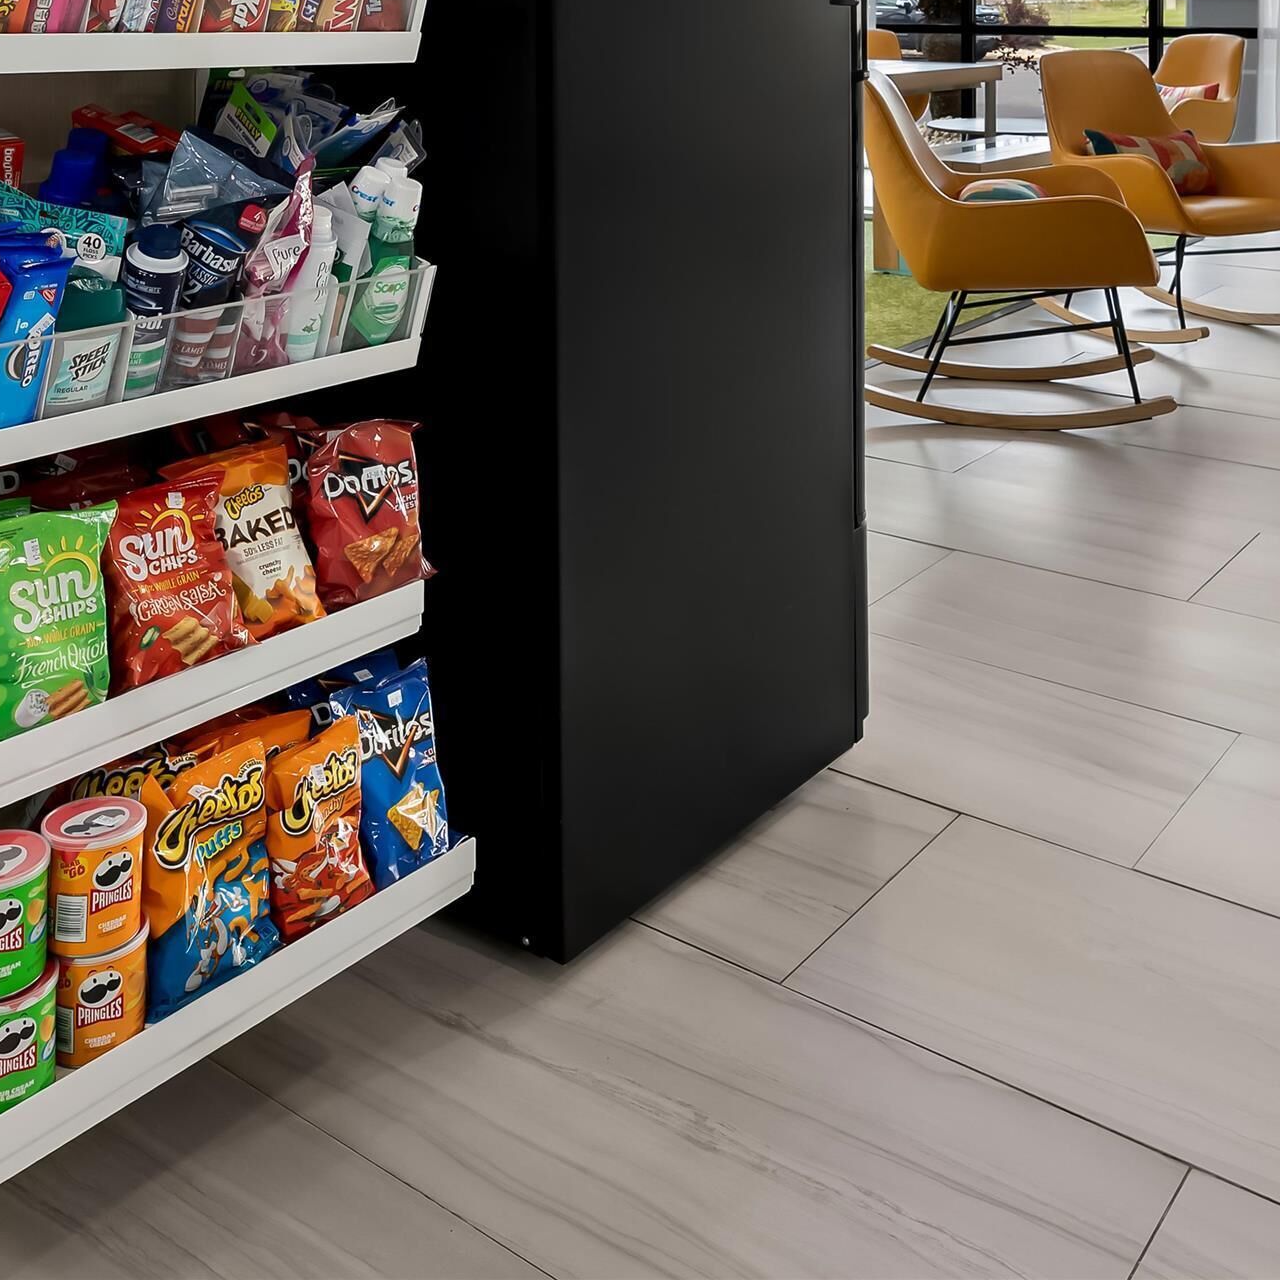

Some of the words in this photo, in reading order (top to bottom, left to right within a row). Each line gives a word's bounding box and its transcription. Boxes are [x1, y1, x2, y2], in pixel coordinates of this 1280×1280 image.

[234, 106, 262, 141] FIREFLY
[3, 147, 16, 186] bounce
[351, 185, 377, 204] Crest
[82, 235, 102, 249] 40
[271, 244, 301, 265] Pure
[374, 281, 407, 295] Scope
[22, 334, 42, 387] OREO
[70, 342, 111, 369] SPEED
[71, 353, 108, 382] STICK
[56, 384, 88, 394] REGULAR
[324, 460, 414, 499] Doritos
[224, 485, 265, 520] Cheetos
[214, 506, 297, 551] BAKED
[119, 525, 194, 581] Sun
[150, 548, 199, 572] CHIPS
[243, 547, 257, 557] 50%
[257, 542, 274, 552] LESS
[259, 559, 282, 571] crunchy
[262, 565, 282, 577] cheese
[155, 576, 176, 591] WHOLE
[177, 570, 200, 586] GRAIN
[9, 570, 92, 634] Sun
[40, 597, 97, 625] CHIPS
[136, 594, 182, 621] GARDEN
[181, 580, 227, 611] SALSA
[44, 629, 69, 646] WHOLE
[70, 622, 96, 639] GRAIN
[13, 647, 67, 686] French
[69, 637, 108, 668] Onion
[283, 749, 358, 832] Cheetos
[155, 770, 265, 869] Cheetos
[195, 820, 243, 868] puffs
[69, 865, 85, 878] GO
[92, 880, 133, 912] PRINGLES
[98, 914, 127, 930] CHEDDAR
[102, 922, 124, 933] CHEESE
[77, 998, 123, 1026] PRINGLES
[84, 1031, 116, 1045] CHEDDAR
[89, 1038, 112, 1048] CHEESE
[10, 1079, 34, 1094] CREAM
